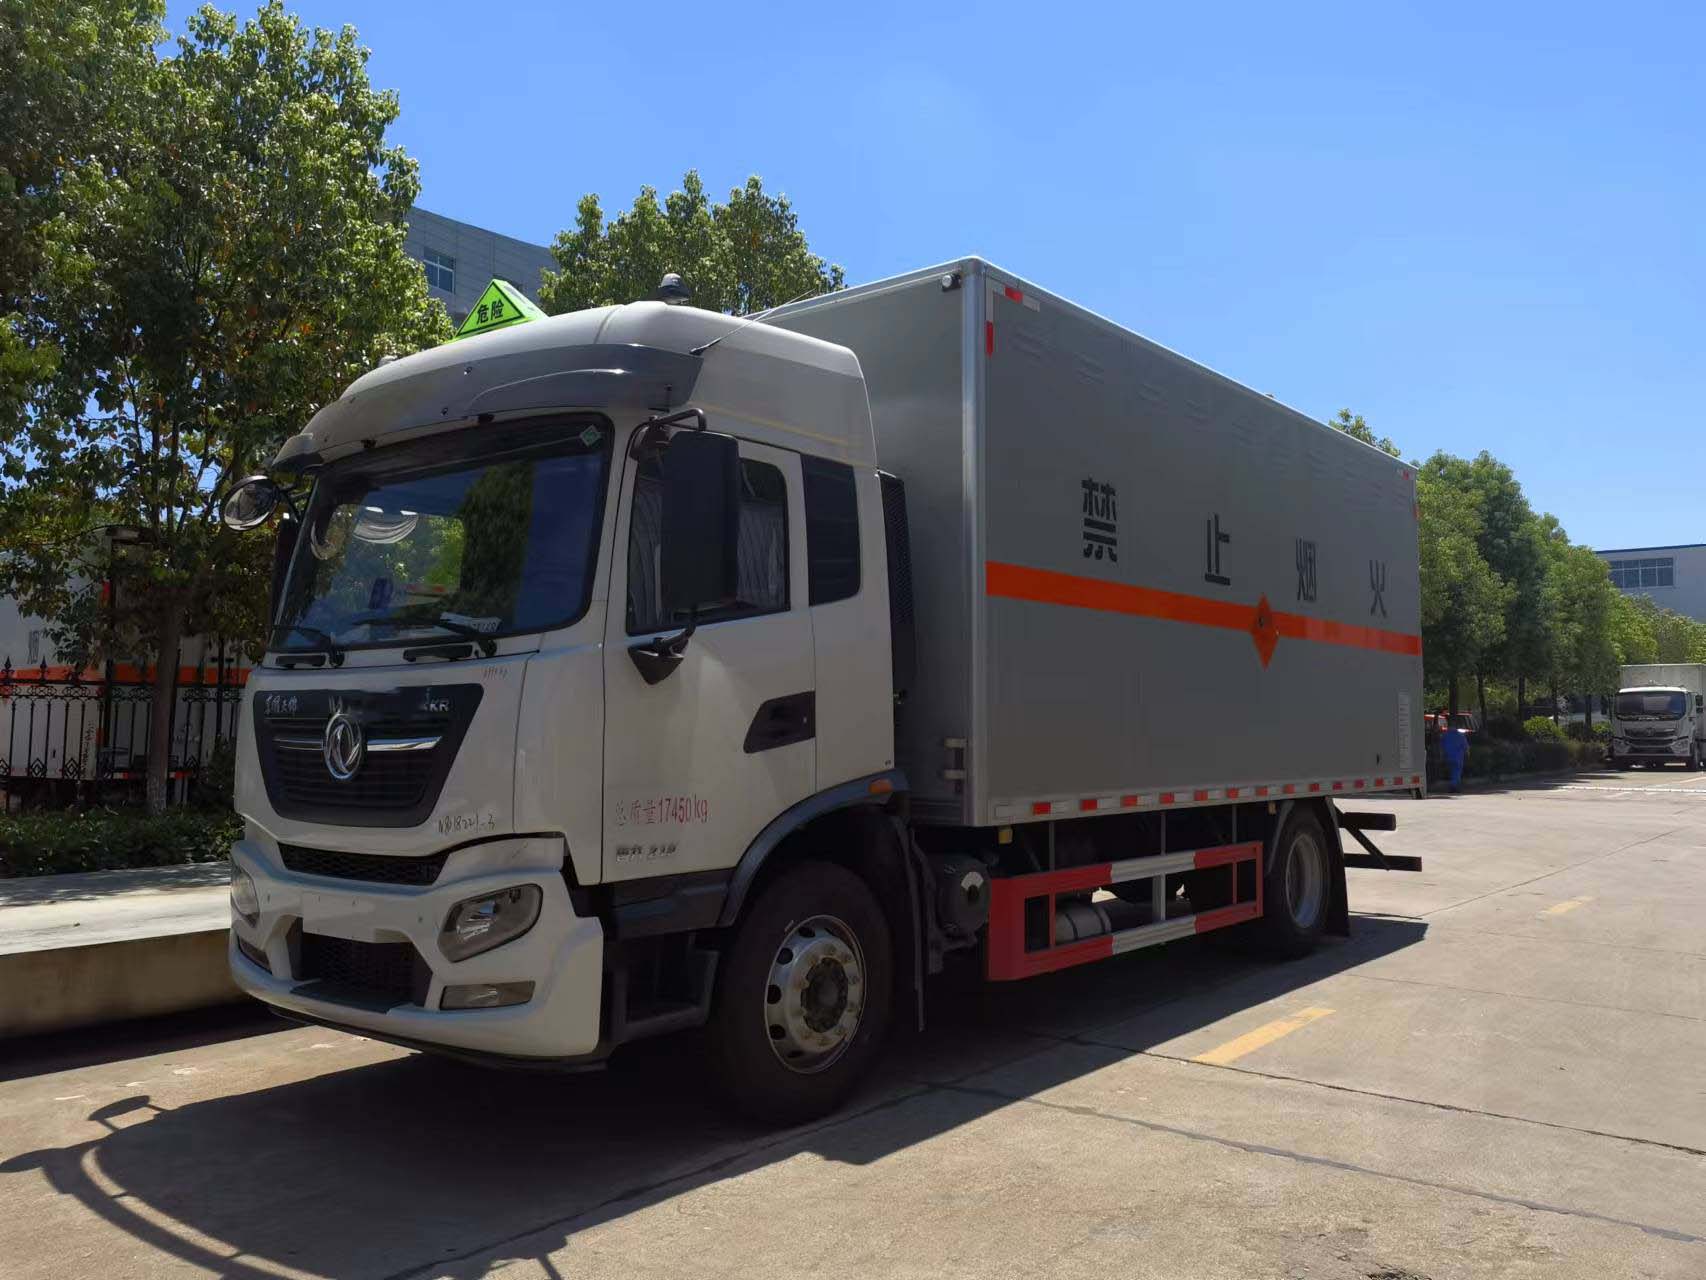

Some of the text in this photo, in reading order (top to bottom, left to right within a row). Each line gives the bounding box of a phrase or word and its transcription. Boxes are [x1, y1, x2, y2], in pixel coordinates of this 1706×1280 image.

[477, 299, 504, 325] 危险
[1082, 477, 1388, 618] 禁止烟火
